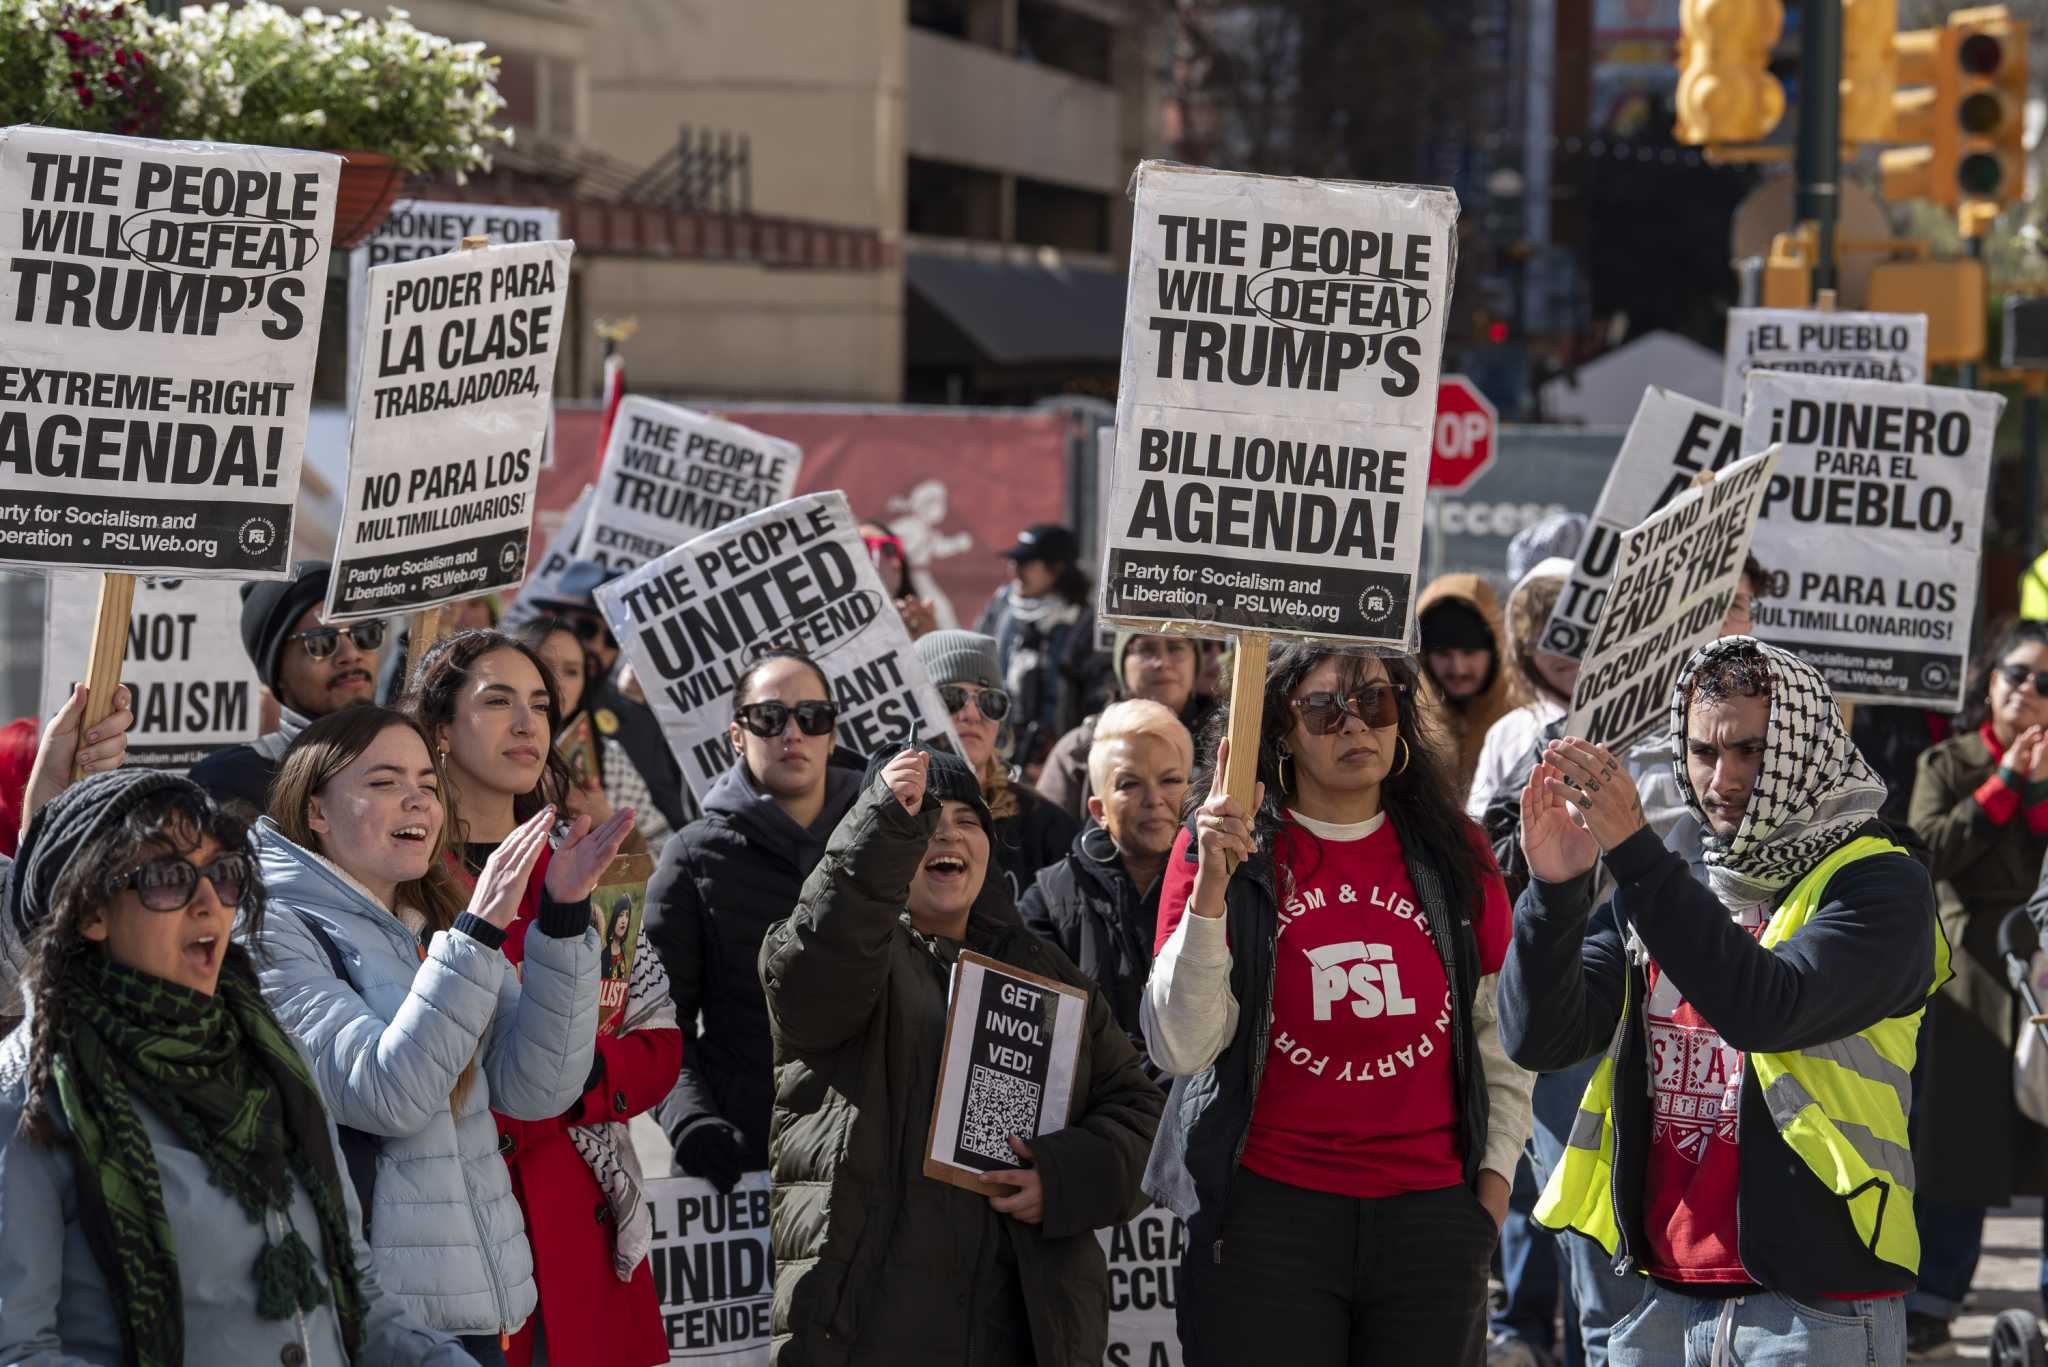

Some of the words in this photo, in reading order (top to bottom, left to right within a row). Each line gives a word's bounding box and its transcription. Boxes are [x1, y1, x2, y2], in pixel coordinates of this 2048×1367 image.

[26, 152, 123, 206] THE
[135, 161, 319, 220] PEOPLE
[22, 208, 132, 260] WILL
[146, 219, 314, 271] DEFEAT
[486, 217, 541, 242] FOR
[1158, 215, 1247, 267] THE
[1260, 223, 1431, 281] PEOPLE
[10, 257, 305, 340] TRUMP'S
[384, 271, 482, 324] ¡PODER
[490, 260, 555, 303] PARA
[1158, 268, 1257, 316] WILL
[1271, 277, 1427, 330] DEFEAT
[378, 325, 425, 378] LA
[438, 305, 552, 369] CLASE
[1149, 317, 1422, 397] TRUMP'S
[1748, 325, 1788, 355] ¡EL
[1800, 325, 1909, 351] PUEBLO
[0, 366, 294, 416] EXTREME-RIGHT
[374, 365, 539, 419] TRABAJADORA,
[0, 411, 284, 487] AGENDA!
[630, 416, 681, 453] THE
[685, 432, 786, 484] PEOPLE
[1770, 399, 1971, 457] ¡DINERO
[361, 472, 400, 511] NO
[407, 459, 476, 503] PARA
[485, 448, 531, 489] LOS
[622, 446, 679, 482] WILL
[687, 465, 779, 508] DEFEAT
[1138, 428, 1407, 494] BILLIONAIRE
[1815, 451, 1881, 477] PARA
[1890, 456, 1918, 480] EL
[34, 504, 62, 522] for
[65, 506, 159, 528] Socialism
[162, 513, 197, 529] and
[355, 492, 526, 544] MULTIMILLONARIOS!
[1126, 479, 1400, 561] AGENDA!
[1626, 499, 1701, 567] STAND
[1709, 455, 1770, 514] WITH
[1758, 475, 1964, 544] PUEBLO,
[102, 533, 218, 557] PSLWeb.org
[348, 567, 383, 583] Party
[383, 563, 400, 578] for
[401, 555, 454, 575] Socialism
[455, 548, 478, 564] and
[621, 566, 697, 625] THE
[695, 505, 835, 590] PEOPLE
[1611, 493, 1755, 609] PALESTINE!
[344, 580, 405, 602] Liberation
[422, 566, 488, 591] PSLWeb.org
[1122, 584, 1208, 606] Liberation
[1234, 594, 1341, 623] PSLWeb.org
[1123, 562, 1169, 583] Party
[1172, 564, 1197, 582] for
[1200, 567, 1286, 592] Socialism
[1288, 578, 1321, 595] and
[1594, 577, 1674, 657] END
[1679, 528, 1746, 602] THE
[1799, 572, 1887, 606] PARA
[1898, 580, 1958, 612] LOS
[123, 613, 197, 662] NOT
[639, 540, 857, 681] UNITED
[1574, 587, 1733, 712] OCCUPATION
[1866, 655, 1894, 671] and
[71, 681, 249, 734] AISM
[665, 658, 741, 715] WILL
[1338, 884, 1358, 903] &
[1370, 886, 1432, 936] LIBE
[600, 980, 629, 1007] LIST
[1001, 983, 1041, 1012] GET
[1311, 962, 1416, 1021] PSL
[985, 1010, 1044, 1047] INVOL
[1274, 1031, 1330, 1077] FOR
[988, 1042, 1033, 1075] VED!
[1336, 1034, 1434, 1082] PARTY
[651, 1238, 777, 1308] NID
